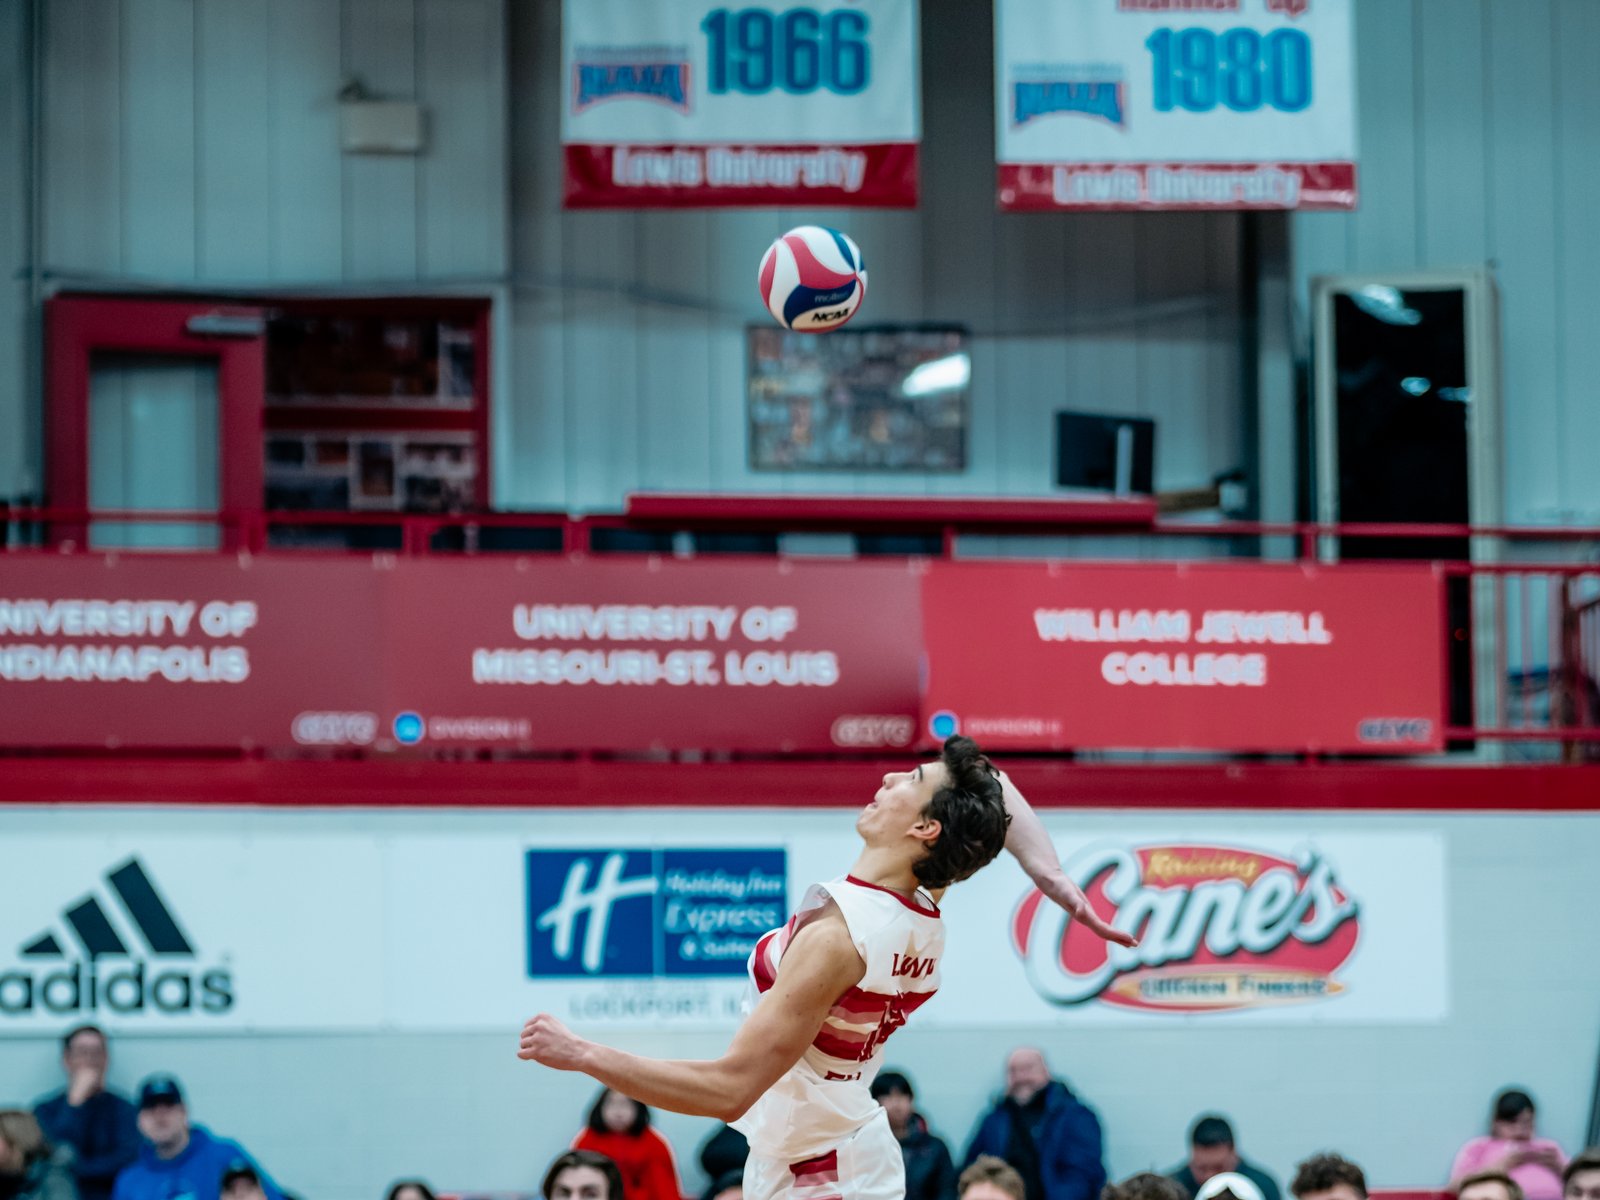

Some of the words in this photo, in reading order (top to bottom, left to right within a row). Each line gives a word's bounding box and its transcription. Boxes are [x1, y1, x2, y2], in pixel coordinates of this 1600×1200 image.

[701, 8, 871, 96] 1966
[1145, 27, 1312, 114] 1980
[613, 146, 701, 187] Lewis
[706, 146, 866, 193] University
[1053, 167, 1144, 205] Lewis
[1147, 166, 1300, 207] University
[812, 308, 849, 322] NCAA
[0, 599, 196, 637] NIVERSITY
[200, 600, 257, 637] OF
[513, 604, 736, 641] UNIVERSITY
[740, 606, 797, 641] OF
[1034, 608, 1191, 643] WILLIAM
[1195, 610, 1332, 645] JEWELL
[724, 651, 839, 686] LOUIS
[1101, 651, 1267, 687] COLLEGE
[664, 870, 746, 899] Holiday
[746, 870, 784, 895] Inn
[664, 898, 779, 935] Express
[1024, 846, 1360, 1005] Cane's
[0, 963, 234, 1013] adidas
